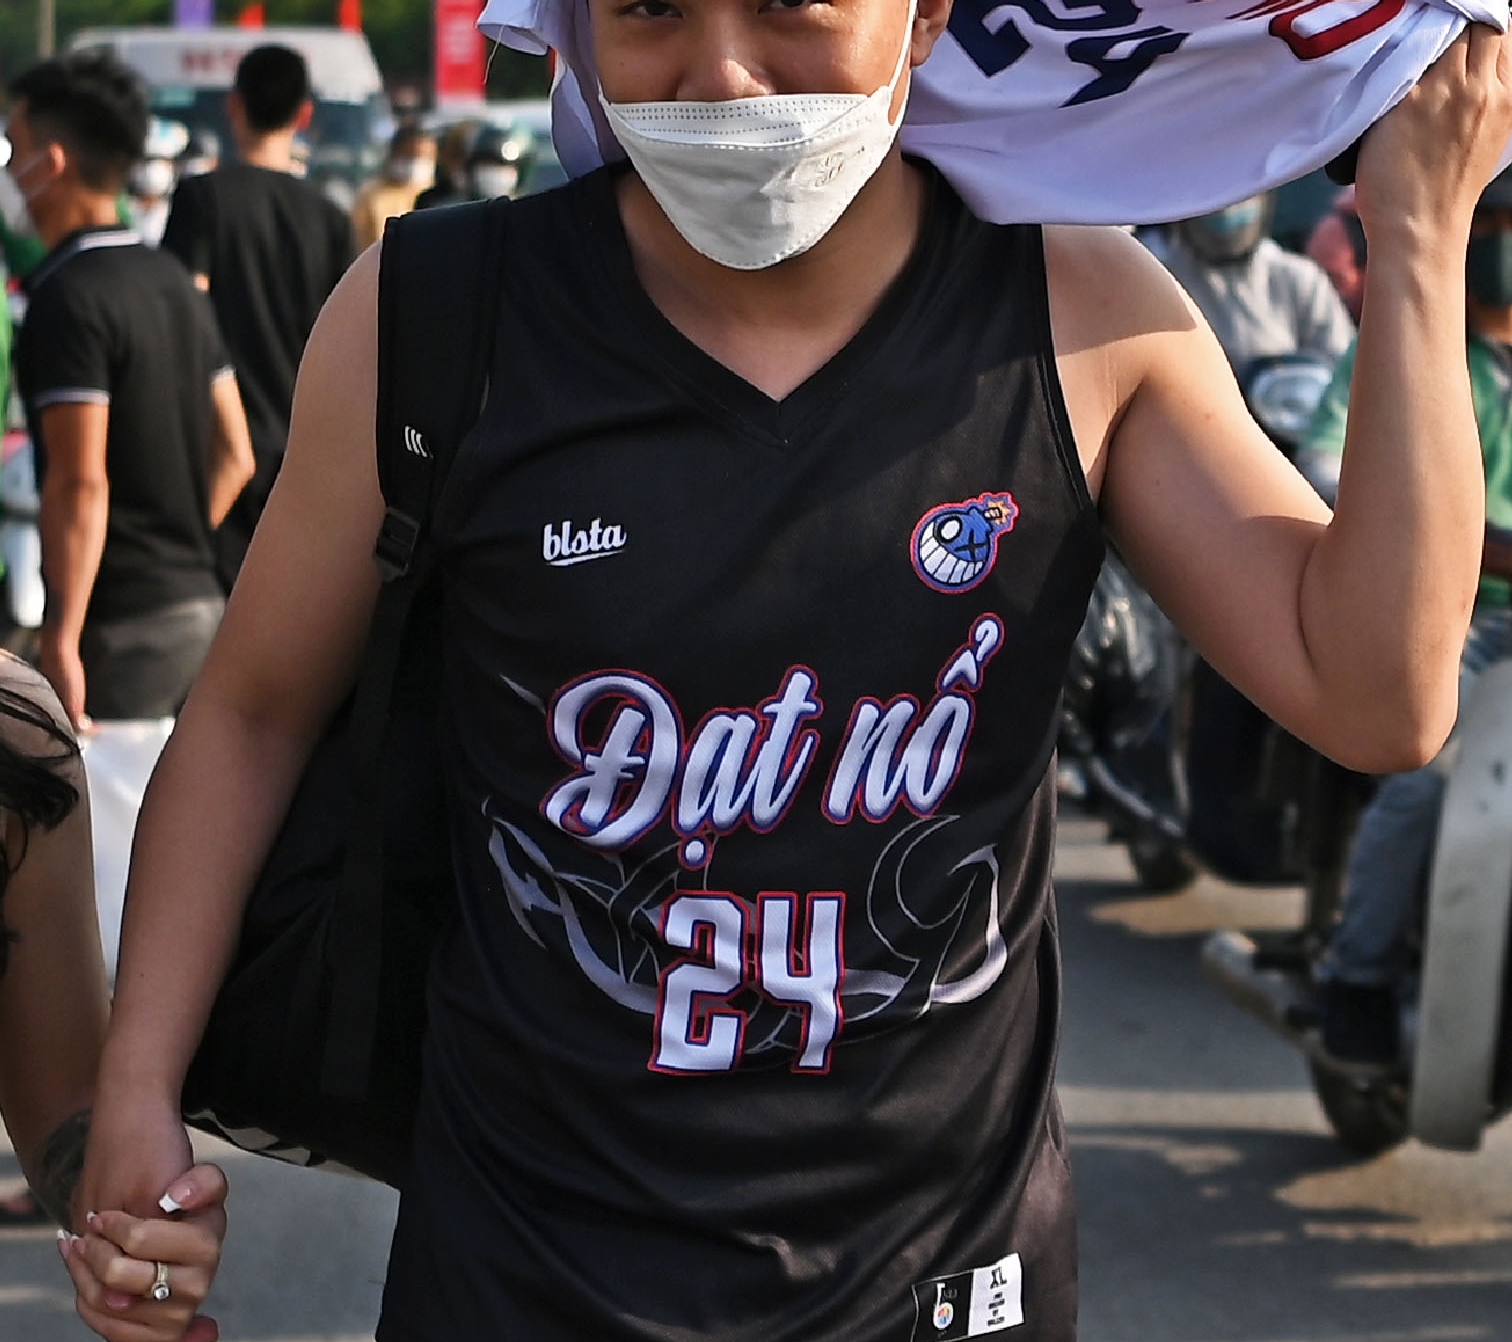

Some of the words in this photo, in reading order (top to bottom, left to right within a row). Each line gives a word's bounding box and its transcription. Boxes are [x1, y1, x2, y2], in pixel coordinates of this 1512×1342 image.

[543, 518, 628, 562] blsta
[541, 666, 823, 870] Đạt
[823, 613, 1005, 825] nổ
[649, 891, 847, 1074] 24
[989, 1266, 1008, 1289] XL
